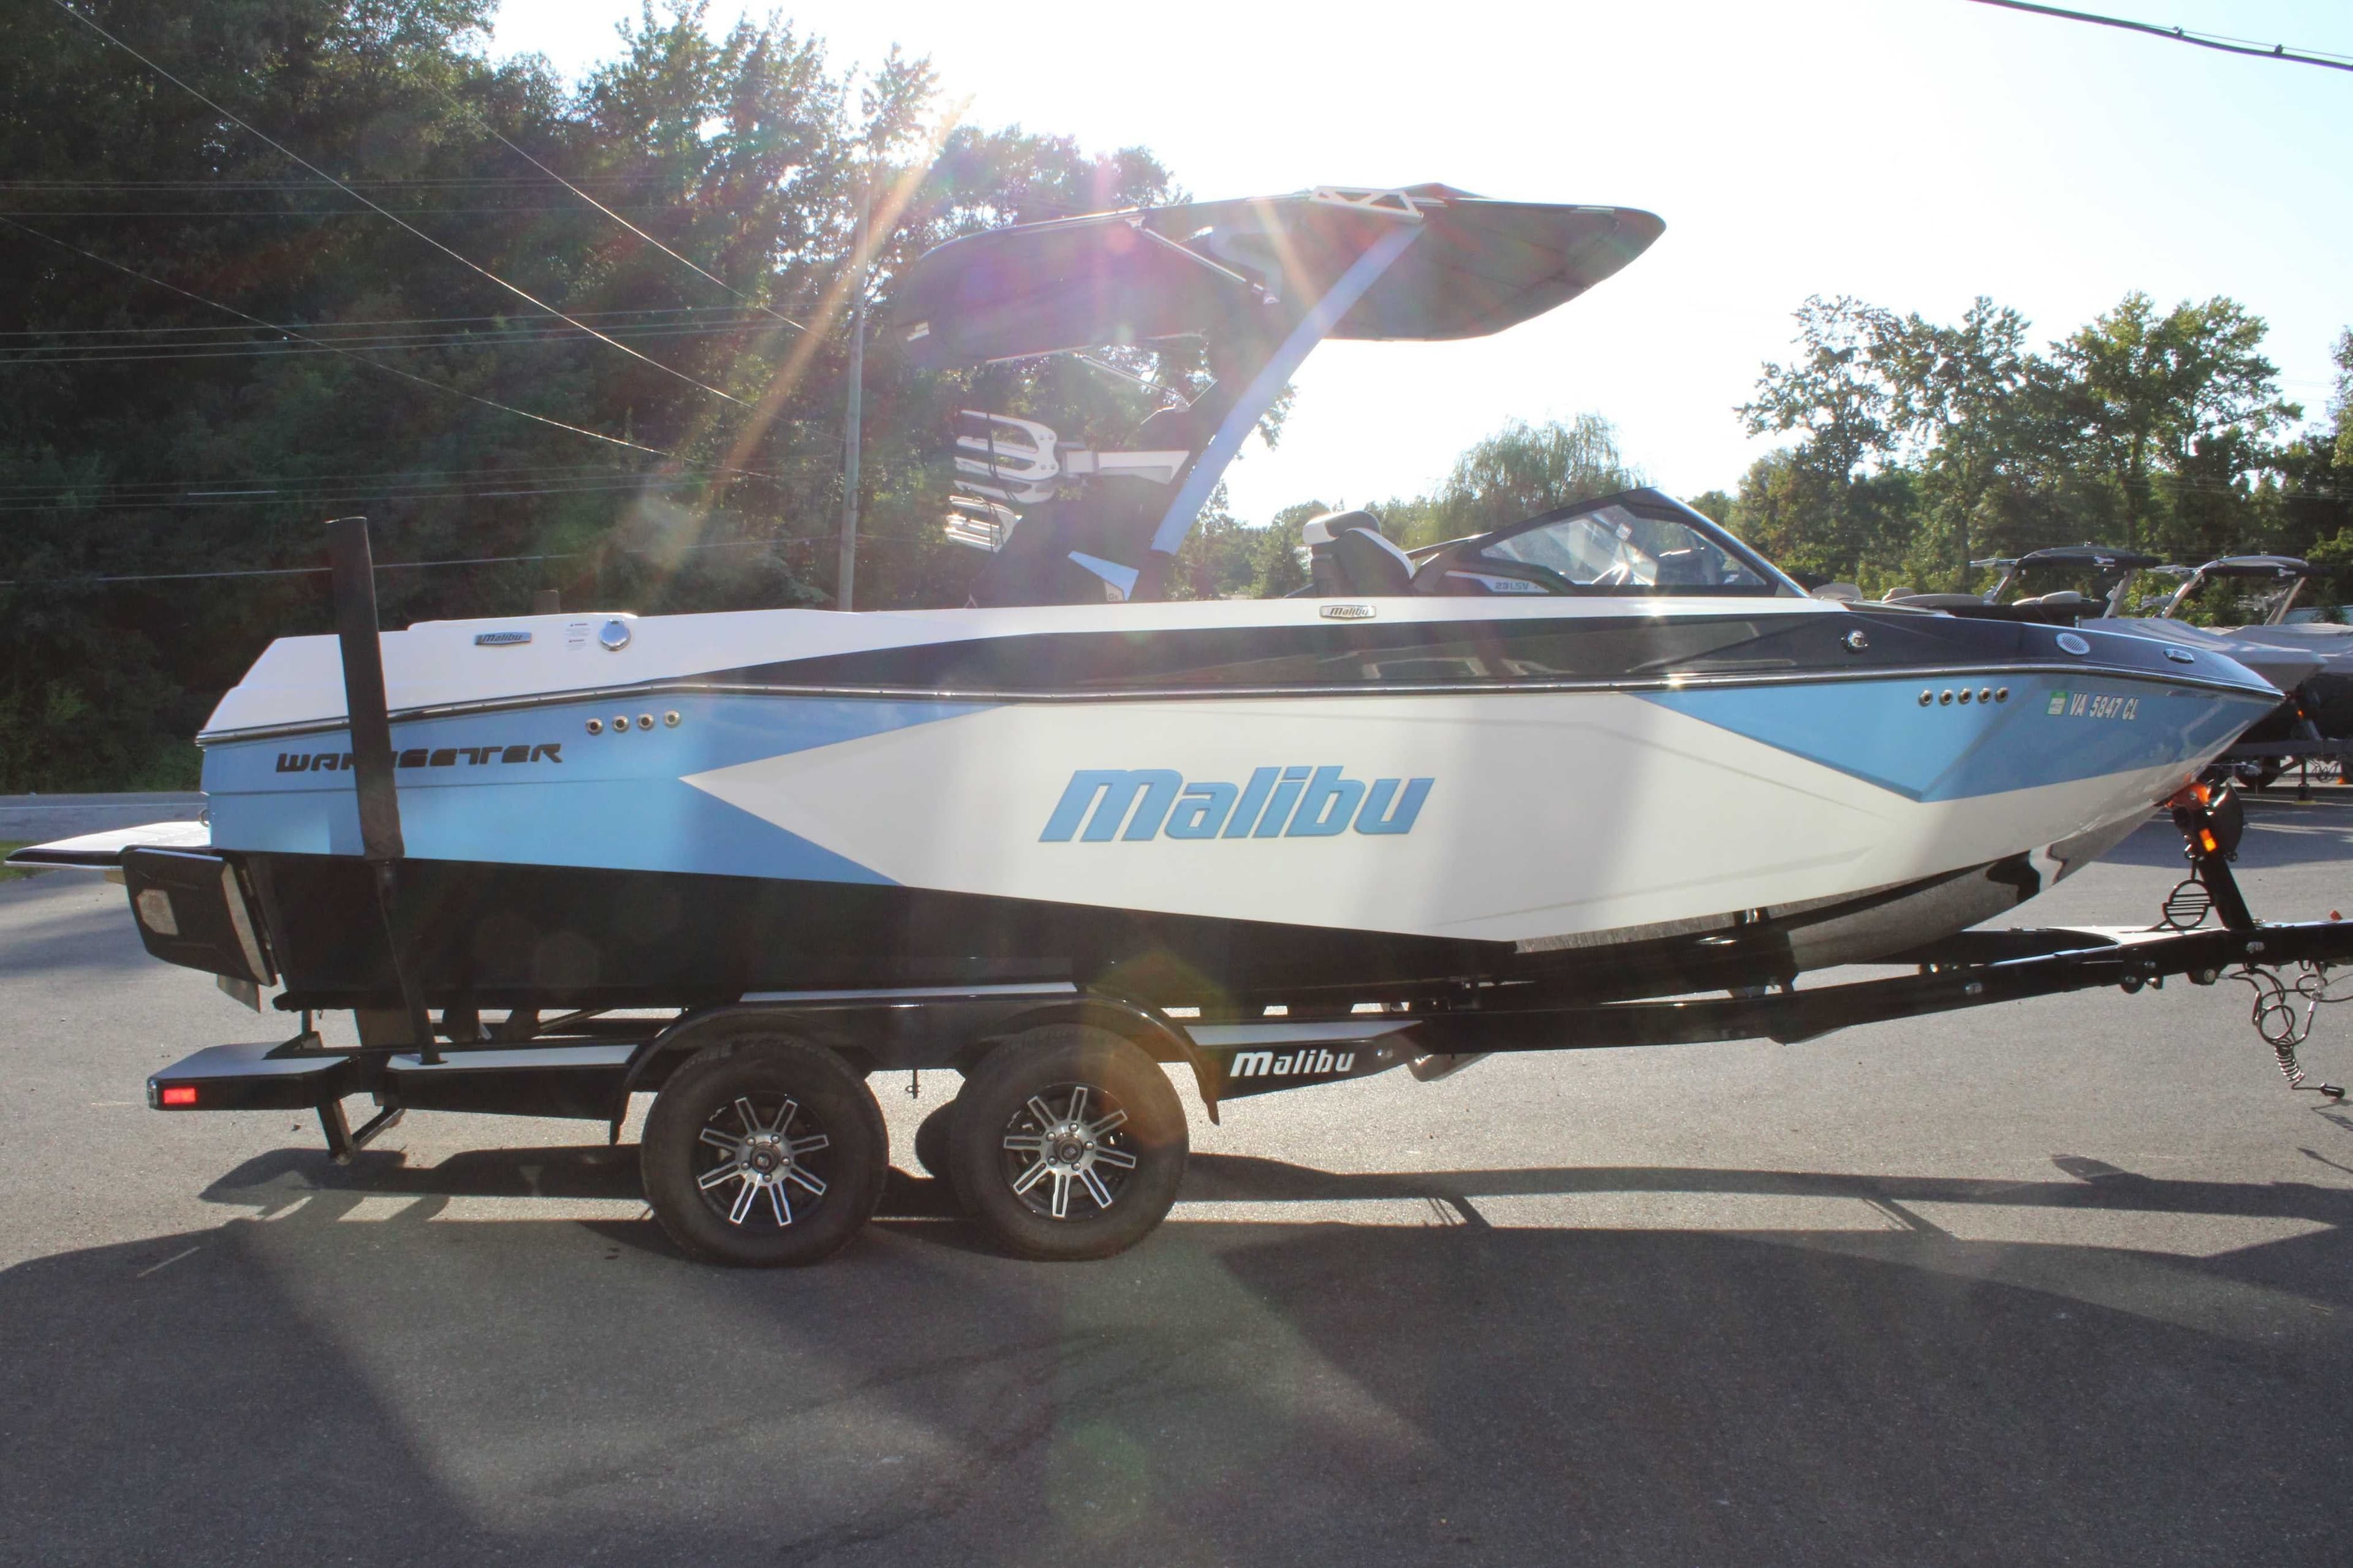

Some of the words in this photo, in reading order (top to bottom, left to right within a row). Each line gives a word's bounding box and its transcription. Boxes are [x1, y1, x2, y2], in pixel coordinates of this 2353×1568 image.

[1330, 607, 1370, 616] Malibu
[482, 633, 523, 643] Malibu
[2069, 692, 2088, 716] VA
[2088, 695, 2124, 719] 5847
[2122, 697, 2140, 721] CL
[276, 743, 563, 773] WASETTER
[1037, 765, 1436, 843] Malibu
[1229, 1048, 1355, 1077] Malibu
